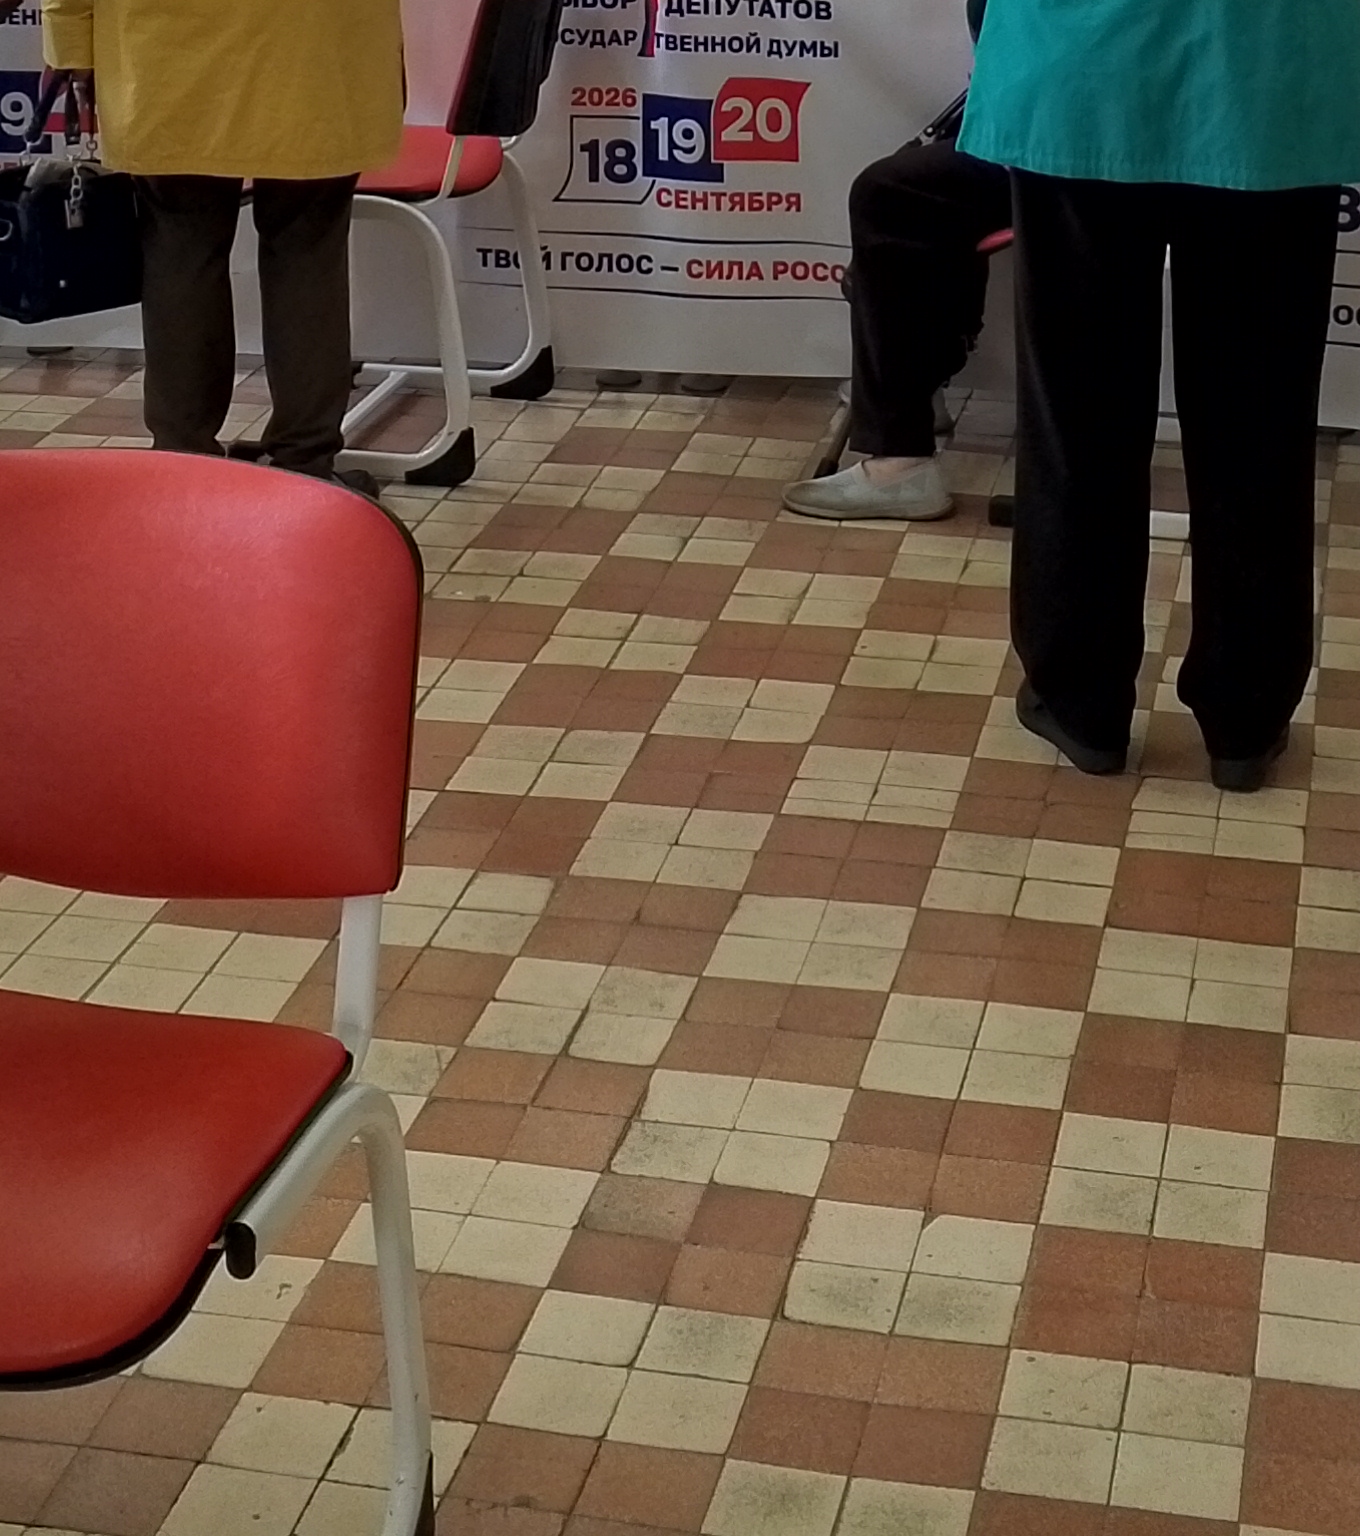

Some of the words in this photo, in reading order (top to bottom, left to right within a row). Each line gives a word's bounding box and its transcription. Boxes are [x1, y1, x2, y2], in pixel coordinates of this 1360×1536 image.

[766, 38, 840, 60] ДУМЫ
[570, 87, 637, 108] 2026
[579, 138, 638, 184] 18
[650, 116, 706, 164] 19
[720, 96, 792, 143] 20
[655, 187, 802, 213] СЕНТЯБРЯ
[560, 251, 654, 275] ГОЛОС
[686, 258, 765, 282] СИЛА
